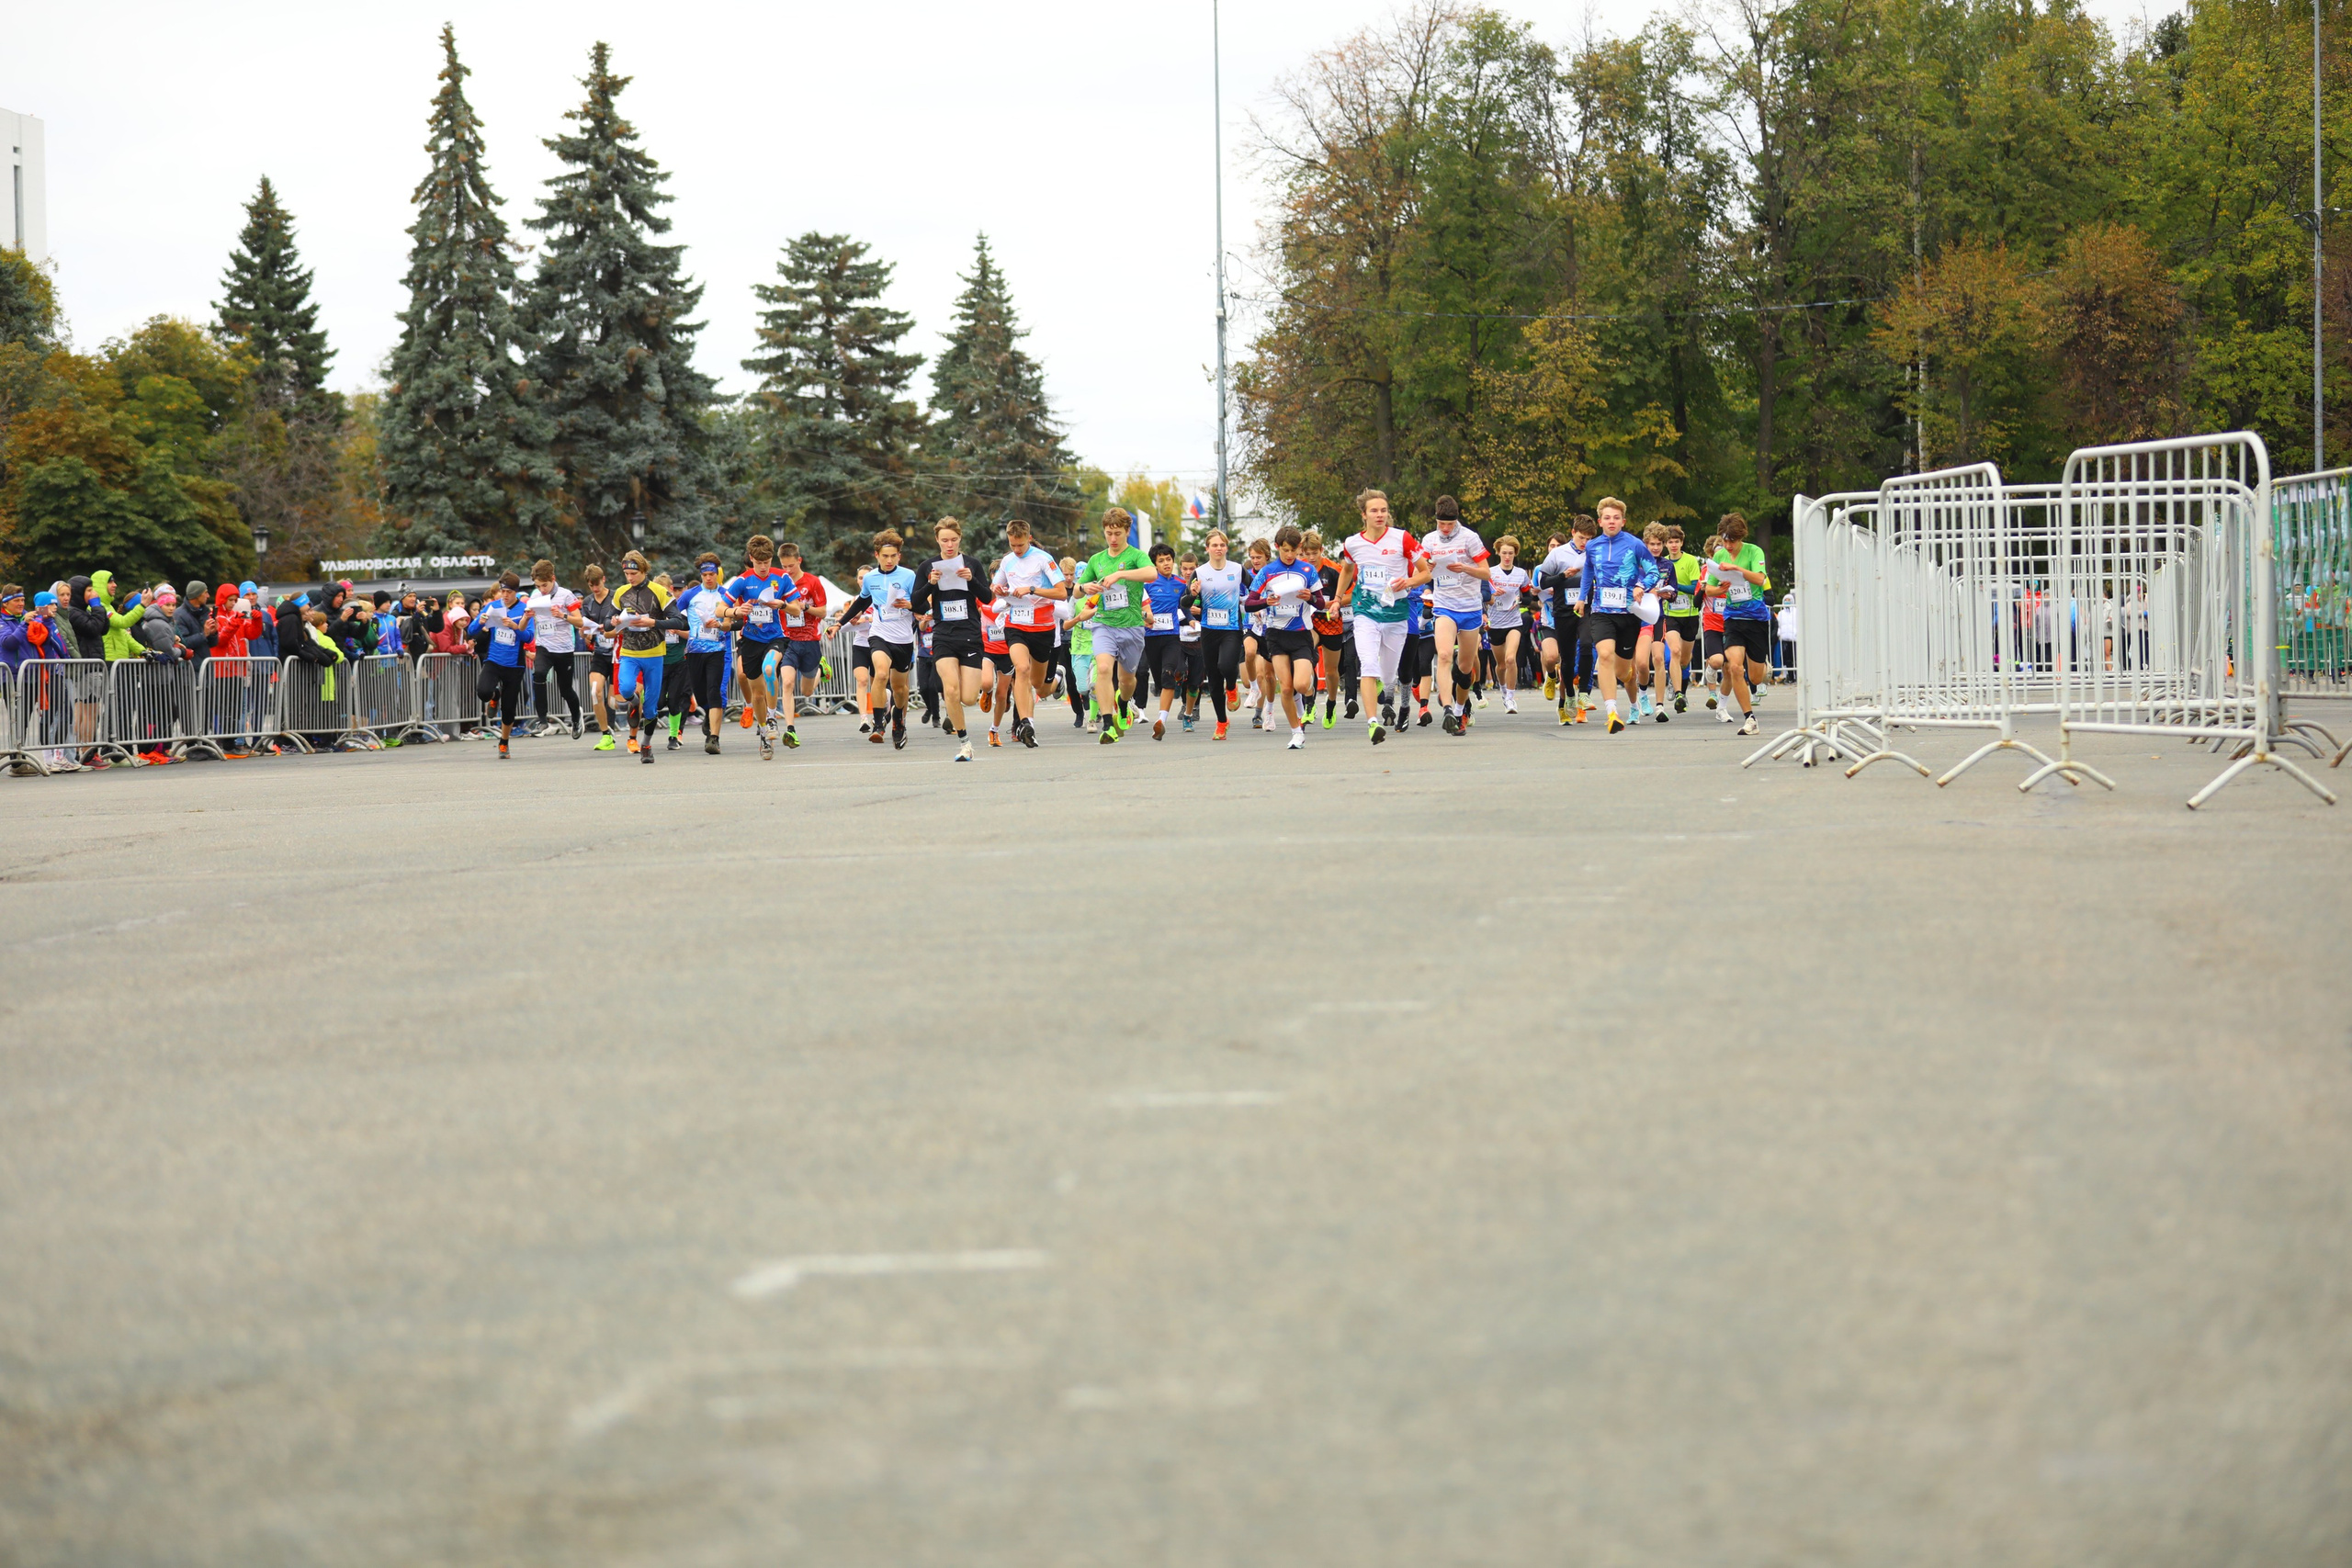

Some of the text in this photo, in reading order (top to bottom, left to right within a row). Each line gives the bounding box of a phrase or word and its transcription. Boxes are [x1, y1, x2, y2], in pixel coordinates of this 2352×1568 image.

[321, 555, 495, 572] УЛЬЯНОВСКАЯ ОБЛАСТЬ
[1364, 570, 1384, 579] 314.1
[1602, 591, 1623, 600] 339.1
[1730, 587, 1747, 596] 320.1
[1105, 593, 1123, 603] 312.1
[496, 630, 513, 639] 321.1
